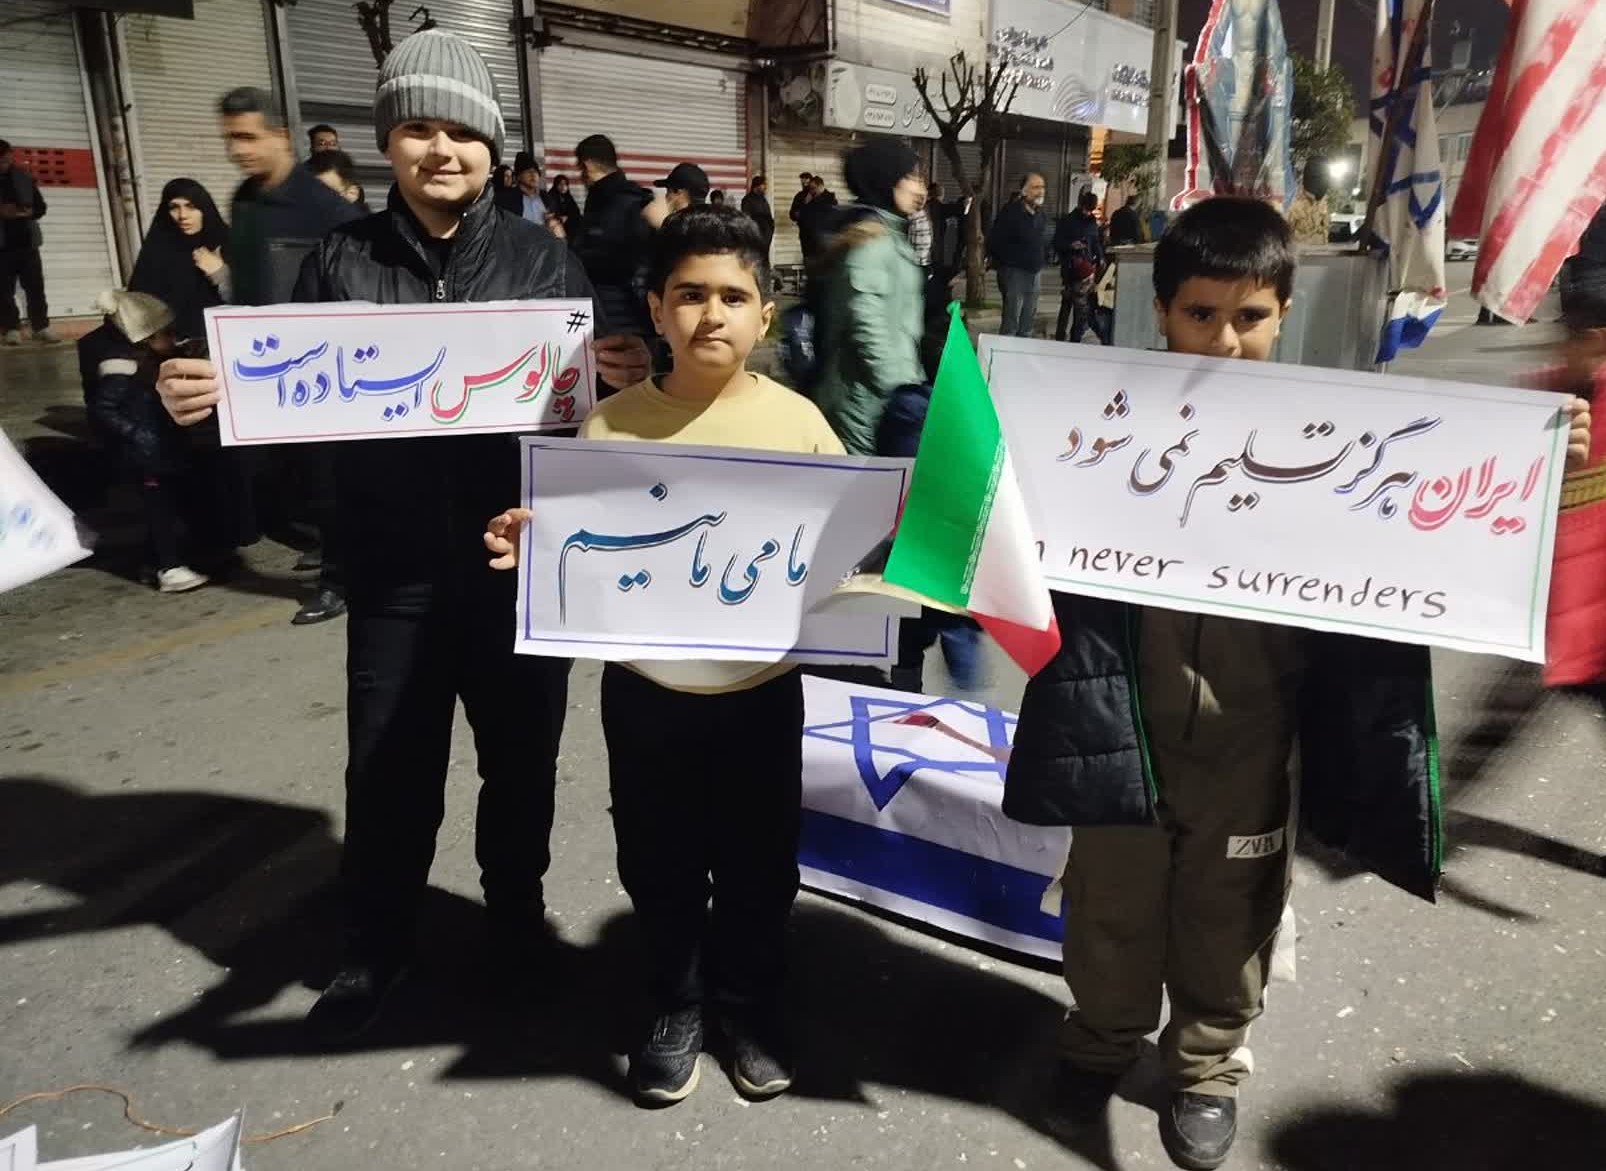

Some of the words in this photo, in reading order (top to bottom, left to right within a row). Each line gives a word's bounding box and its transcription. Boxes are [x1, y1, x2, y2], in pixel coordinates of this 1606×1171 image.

[1179, 420, 1356, 529] تسلیم
[1333, 415, 1444, 520] هرگز
[1408, 455, 1545, 535] ایران
[786, 523, 809, 587] ما
[1068, 544, 1185, 580] never
[1207, 564, 1447, 619] surrenders
